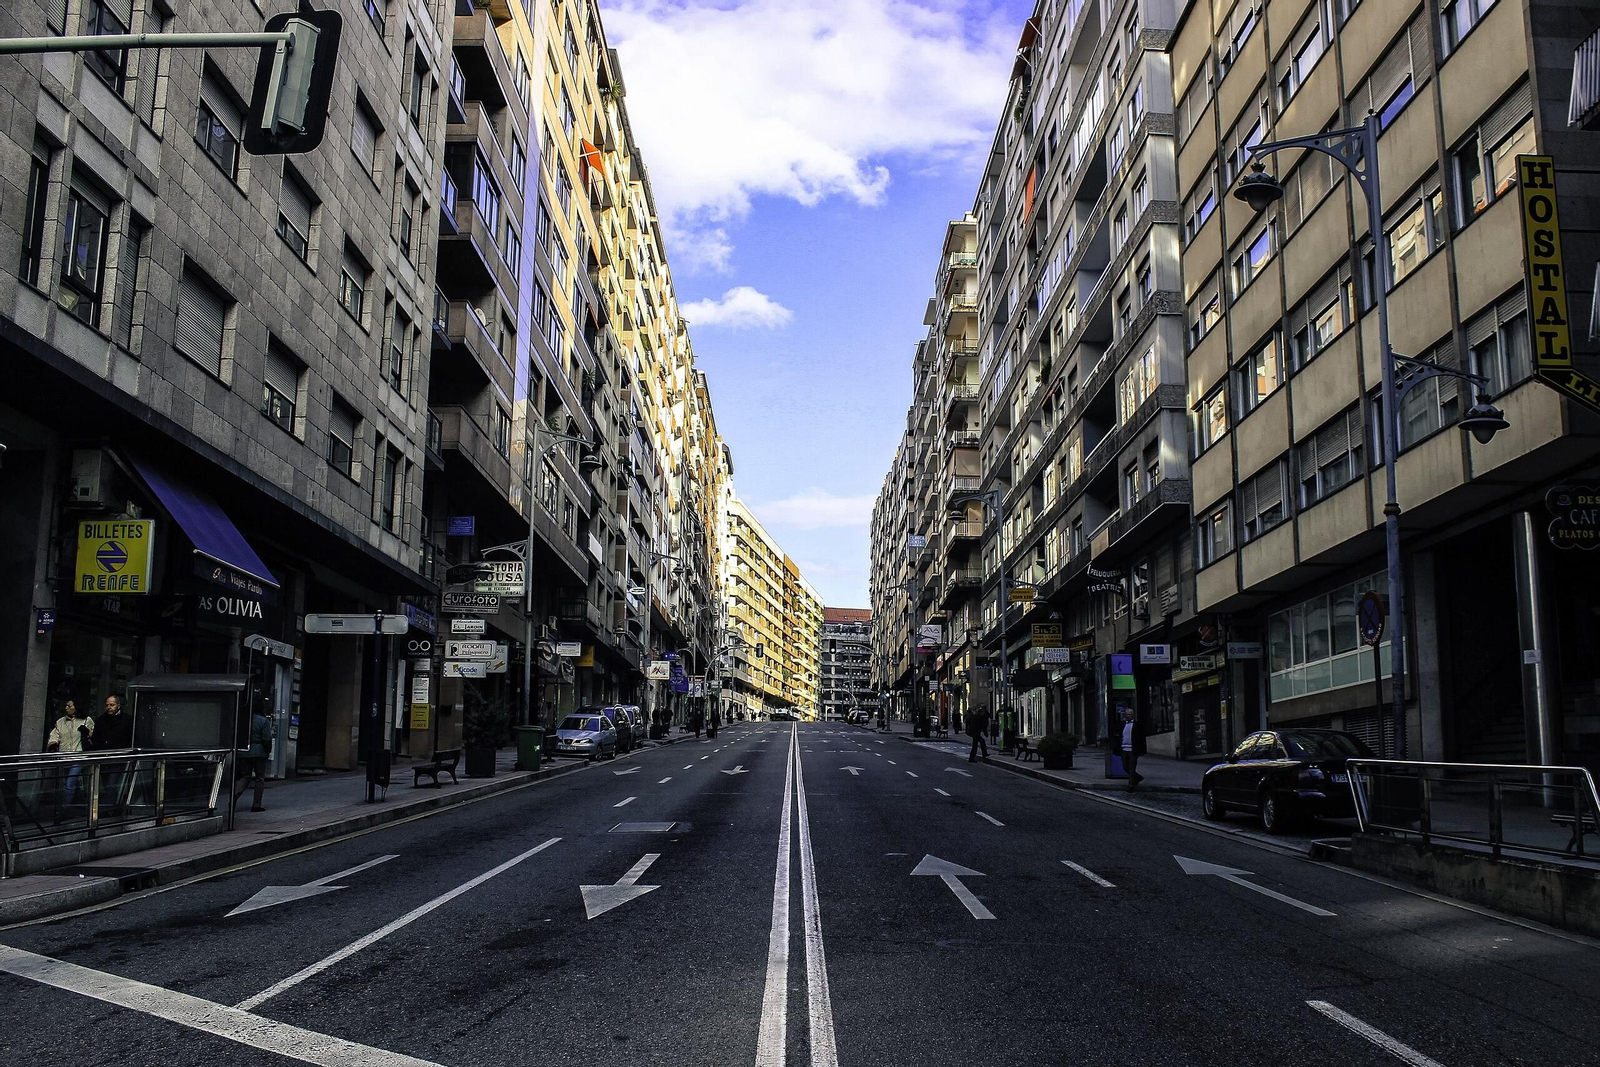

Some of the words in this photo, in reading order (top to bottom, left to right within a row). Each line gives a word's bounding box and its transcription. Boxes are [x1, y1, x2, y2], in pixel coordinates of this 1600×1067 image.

[1522, 161, 1568, 360] HOSTAL
[1565, 372, 1600, 407] LI
[84, 524, 143, 538] BILLETES
[1559, 529, 1595, 539] PLATOS
[81, 574, 140, 590] RENFE
[1091, 583, 1122, 593] BEATRIZ
[103, 598, 121, 614] STAR
[216, 596, 263, 619] OLIVIA
